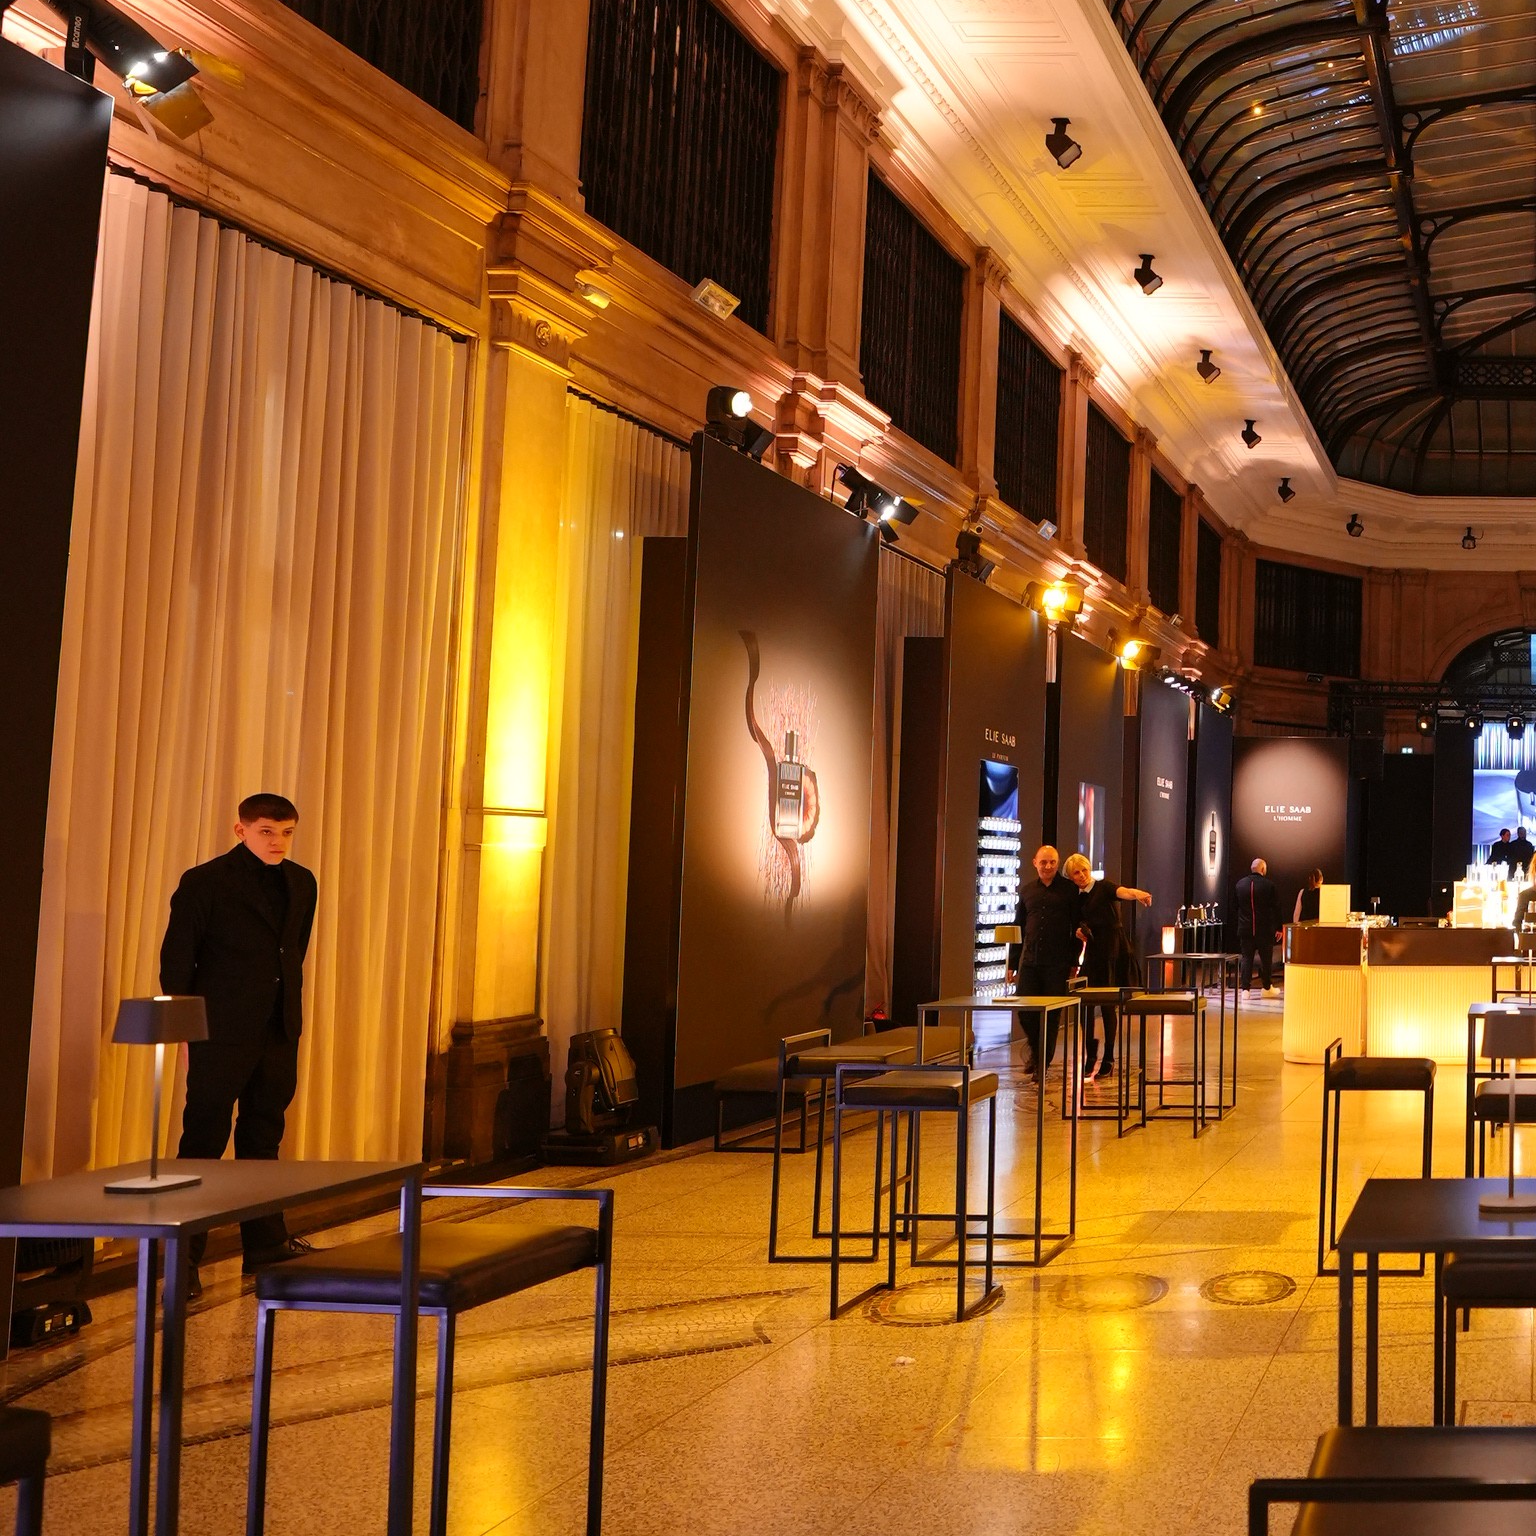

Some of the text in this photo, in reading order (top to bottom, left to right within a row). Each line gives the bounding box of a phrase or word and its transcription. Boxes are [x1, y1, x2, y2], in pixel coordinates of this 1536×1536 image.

[985, 728, 1016, 748] ELIE SAAB
[1264, 805, 1312, 814] ELIE SAAB
